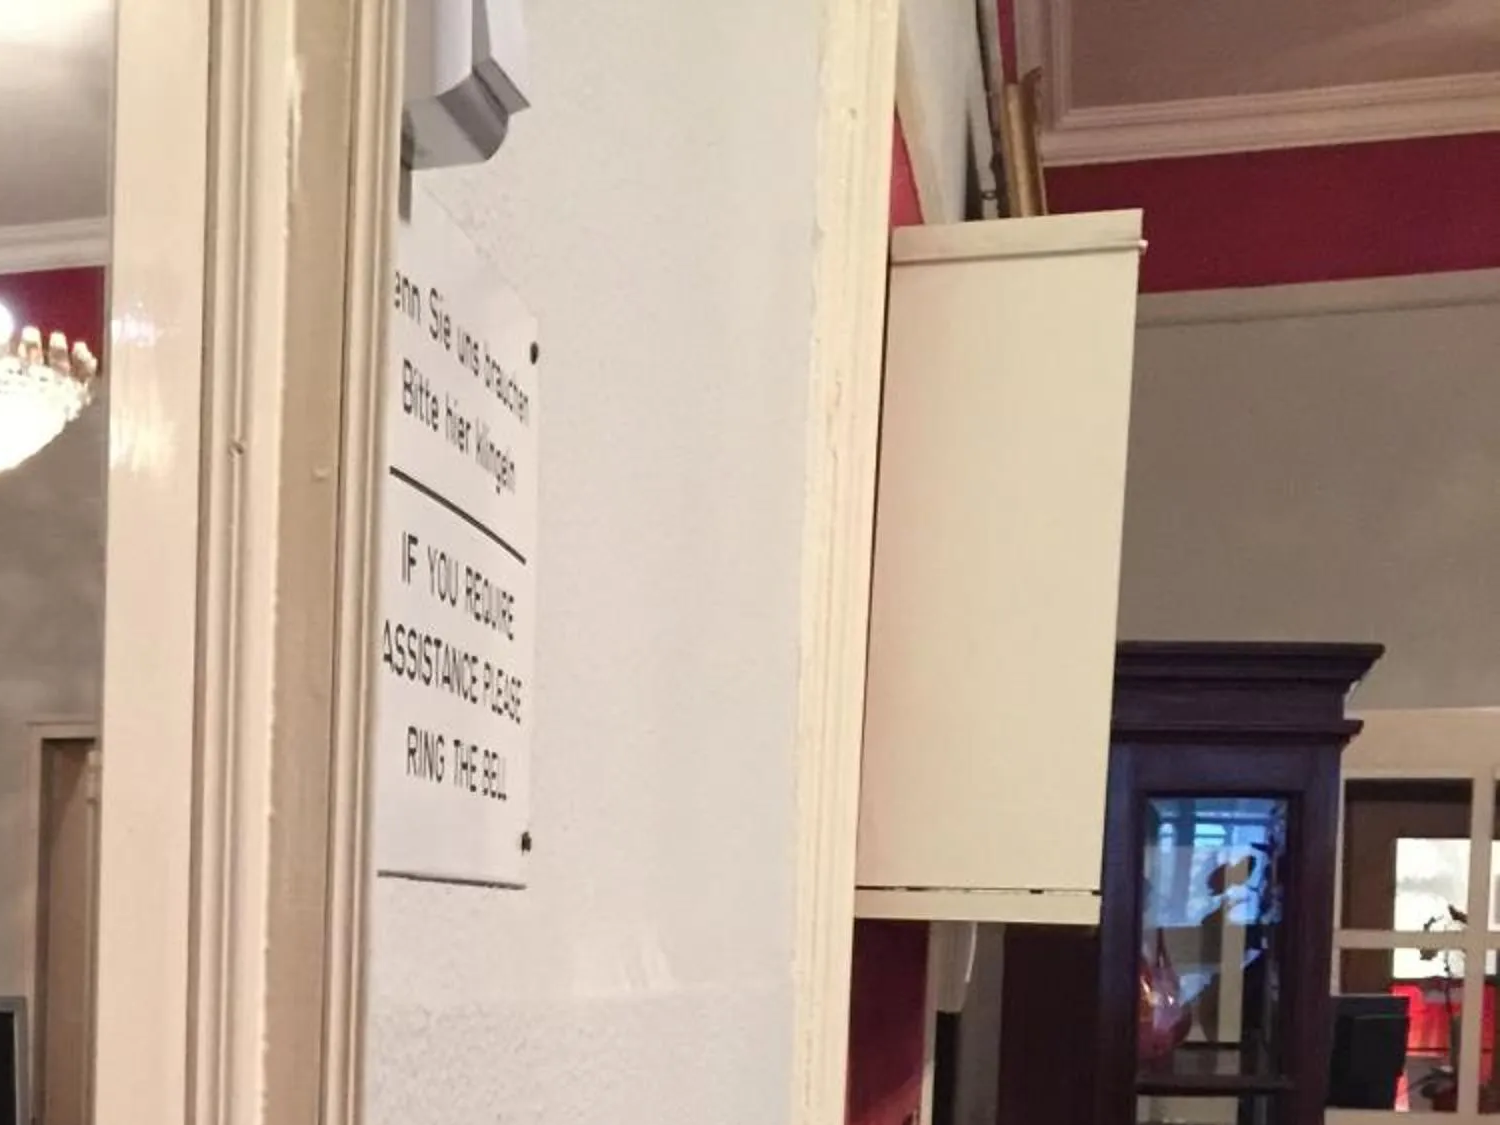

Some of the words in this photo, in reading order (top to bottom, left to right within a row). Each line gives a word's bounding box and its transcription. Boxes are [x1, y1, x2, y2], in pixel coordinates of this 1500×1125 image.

[429, 287, 451, 351] Sie
[457, 325, 479, 376] uns
[403, 358, 439, 432] Bitte
[445, 391, 471, 454] hier
[401, 531, 419, 584] IF
[427, 545, 459, 608] YOU
[464, 566, 514, 641] REQUIRE
[383, 619, 479, 704] ASSISTANCE
[483, 661, 522, 725] PLEASE
[406, 725, 445, 784] RING
[453, 738, 478, 793] THE
[482, 748, 507, 801] BELL
